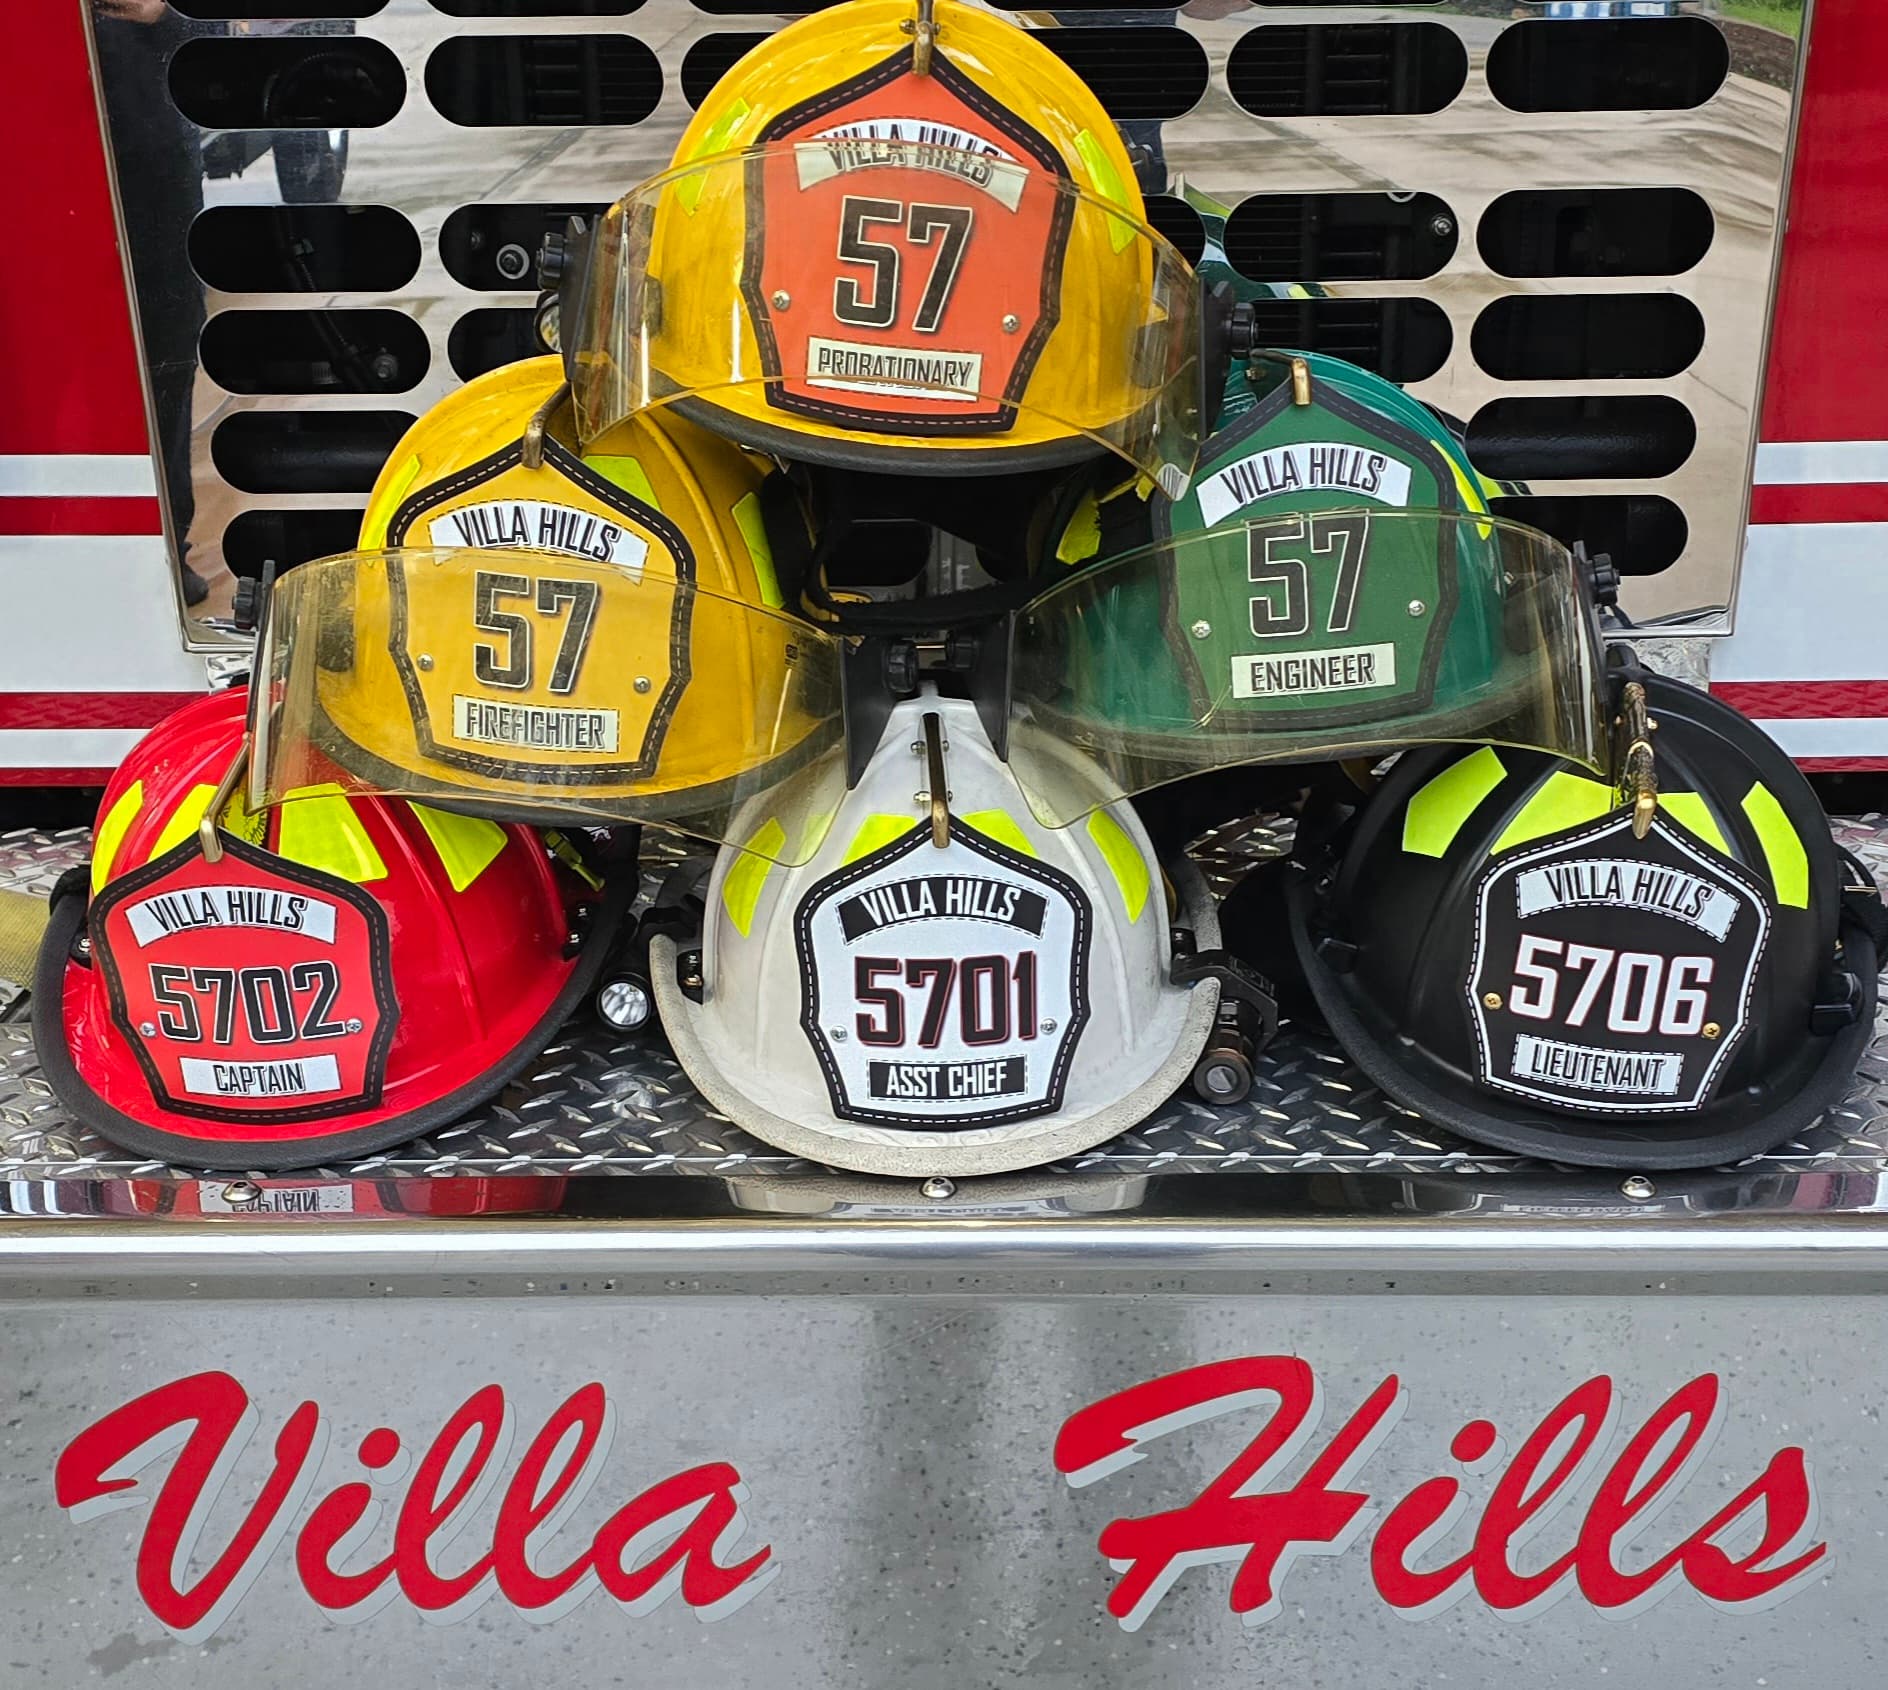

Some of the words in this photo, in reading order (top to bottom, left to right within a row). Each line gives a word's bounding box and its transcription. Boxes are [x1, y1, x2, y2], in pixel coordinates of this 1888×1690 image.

[821, 124, 905, 172] VILLA
[916, 126, 998, 188] HILLS
[834, 194, 974, 333] 57
[818, 347, 973, 388] PROBATIONARY
[1220, 449, 1302, 505] VILLA
[1309, 447, 1387, 495] HILLS
[453, 505, 530, 548] VILLA
[537, 507, 622, 563] HILLS
[1245, 508, 1369, 637] 57
[473, 570, 601, 693] 57
[1250, 653, 1376, 693] ENGINEER
[465, 703, 606, 749] FIREFIGHTER
[145, 891, 220, 931] VILLA
[226, 889, 309, 930] HILLS
[859, 880, 937, 926] VILLA
[944, 879, 1021, 922] HILLS
[1544, 866, 1623, 903] VILLA
[1632, 868, 1713, 920] HILLS
[148, 961, 347, 1045] 5702
[854, 950, 1038, 1049] 5701
[1508, 934, 1715, 1035] 5706
[212, 1063, 306, 1094] CAPTAIN
[885, 1065, 941, 1096] ASST
[948, 1062, 1009, 1095] CHIEF
[1530, 1045, 1665, 1090] LIEUTENANT
[55, 1370, 776, 1638] Villa
[1053, 1355, 1832, 1624] Hills
